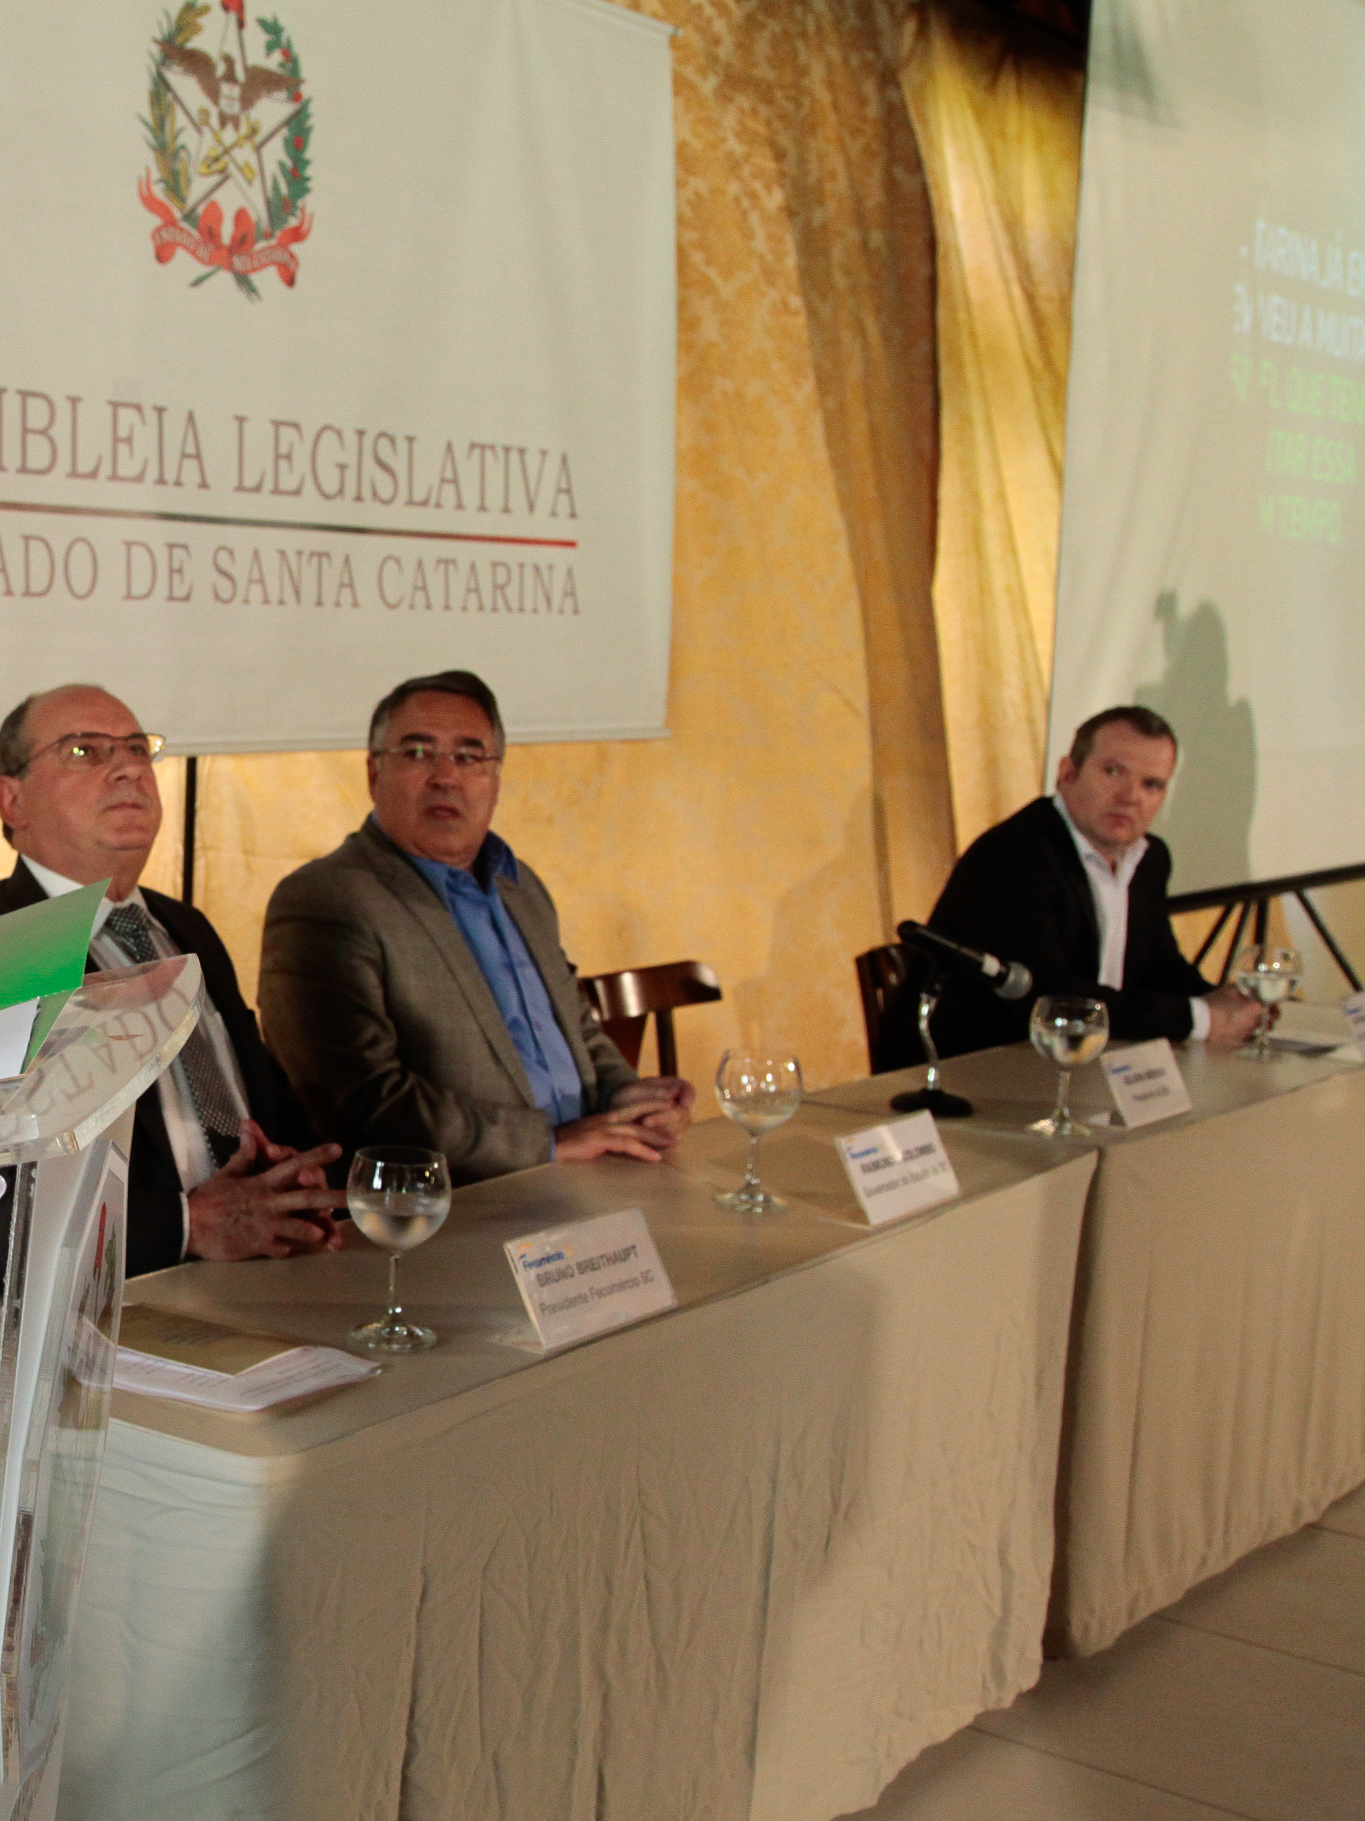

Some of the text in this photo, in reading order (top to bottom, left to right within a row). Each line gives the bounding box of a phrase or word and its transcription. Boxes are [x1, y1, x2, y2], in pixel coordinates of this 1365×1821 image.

[234, 415, 578, 519] LEGISLATIVA
[122, 540, 194, 602] DE
[212, 545, 360, 610] SANTA
[376, 555, 582, 616] CATARINA
